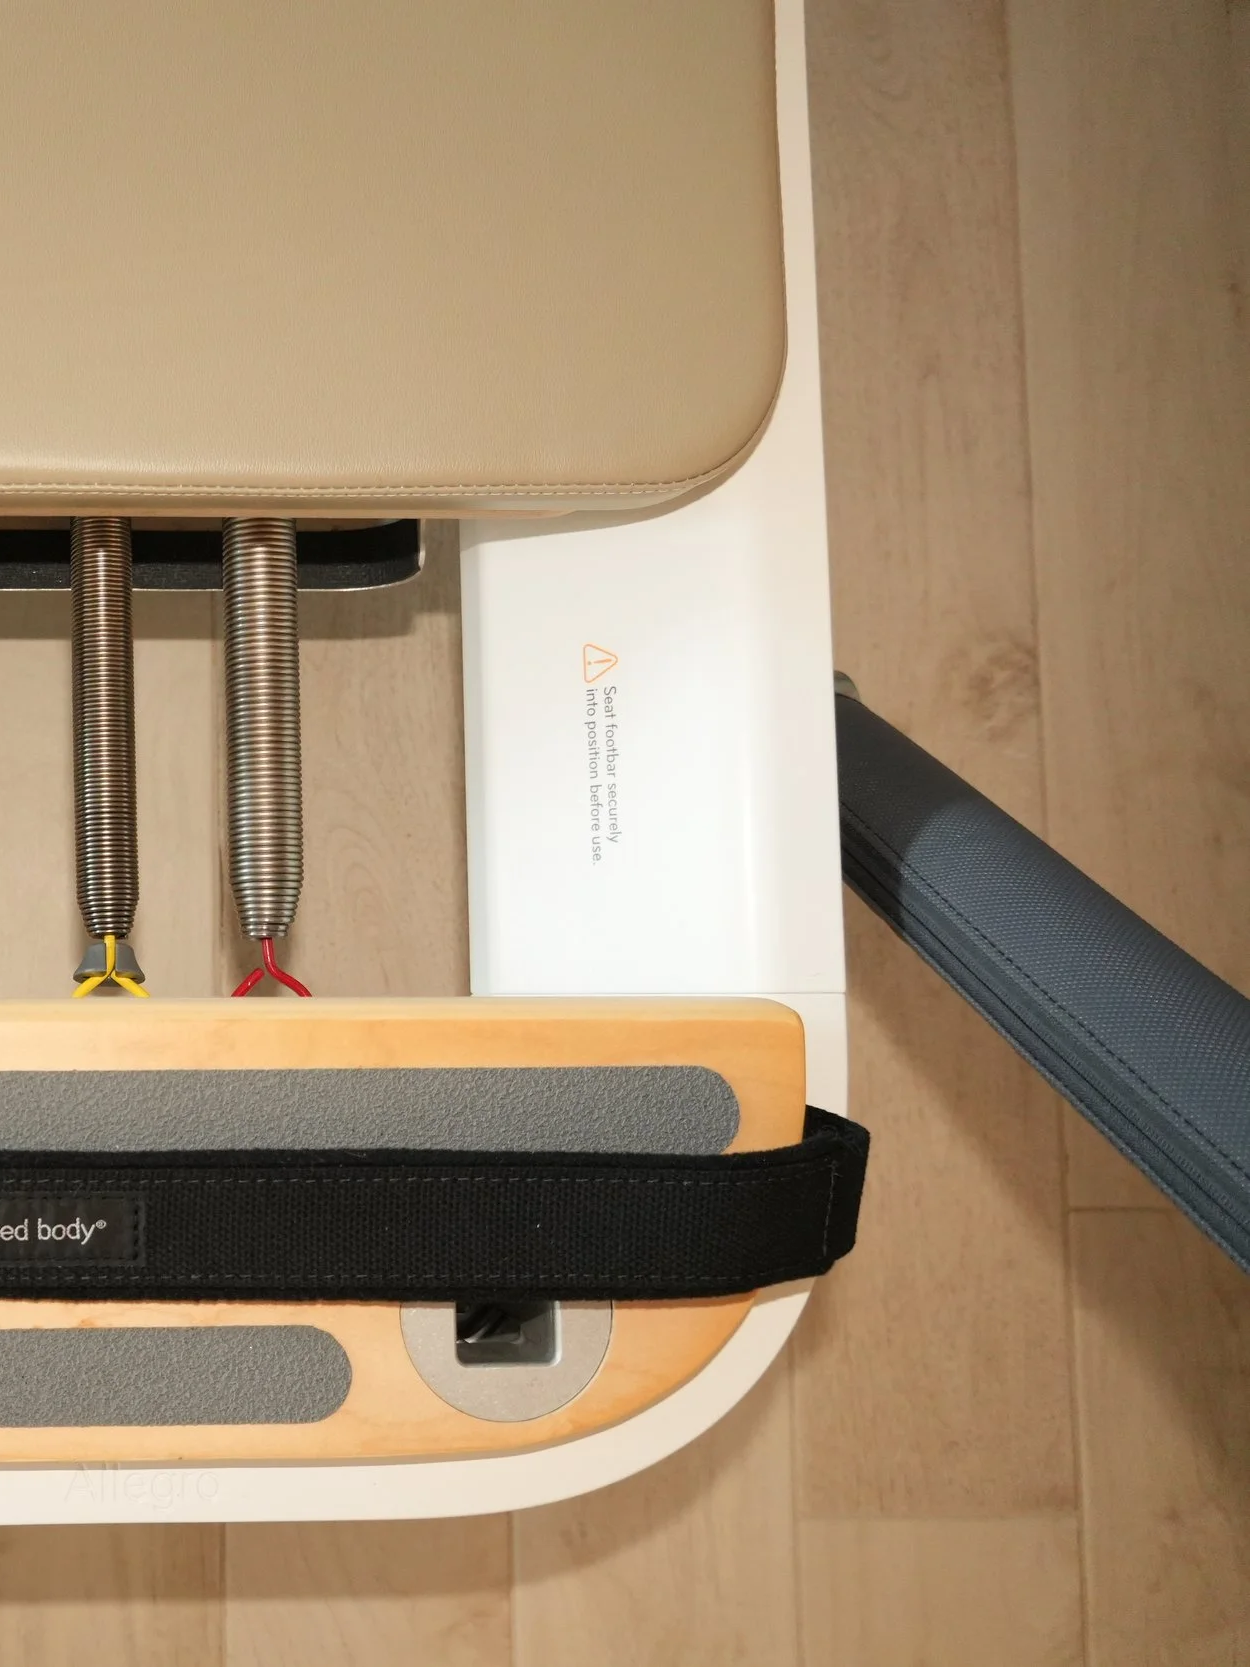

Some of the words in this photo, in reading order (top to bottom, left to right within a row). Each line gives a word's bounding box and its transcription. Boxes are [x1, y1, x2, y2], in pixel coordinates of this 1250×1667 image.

[586, 688, 598, 717] into
[603, 685, 617, 719] Seat
[584, 721, 600, 779] position
[605, 723, 619, 778] footbar
[590, 784, 602, 831] before
[606, 783, 622, 843] securely
[591, 836, 602, 866] use.
[63, 1462, 221, 1511] Allegro
